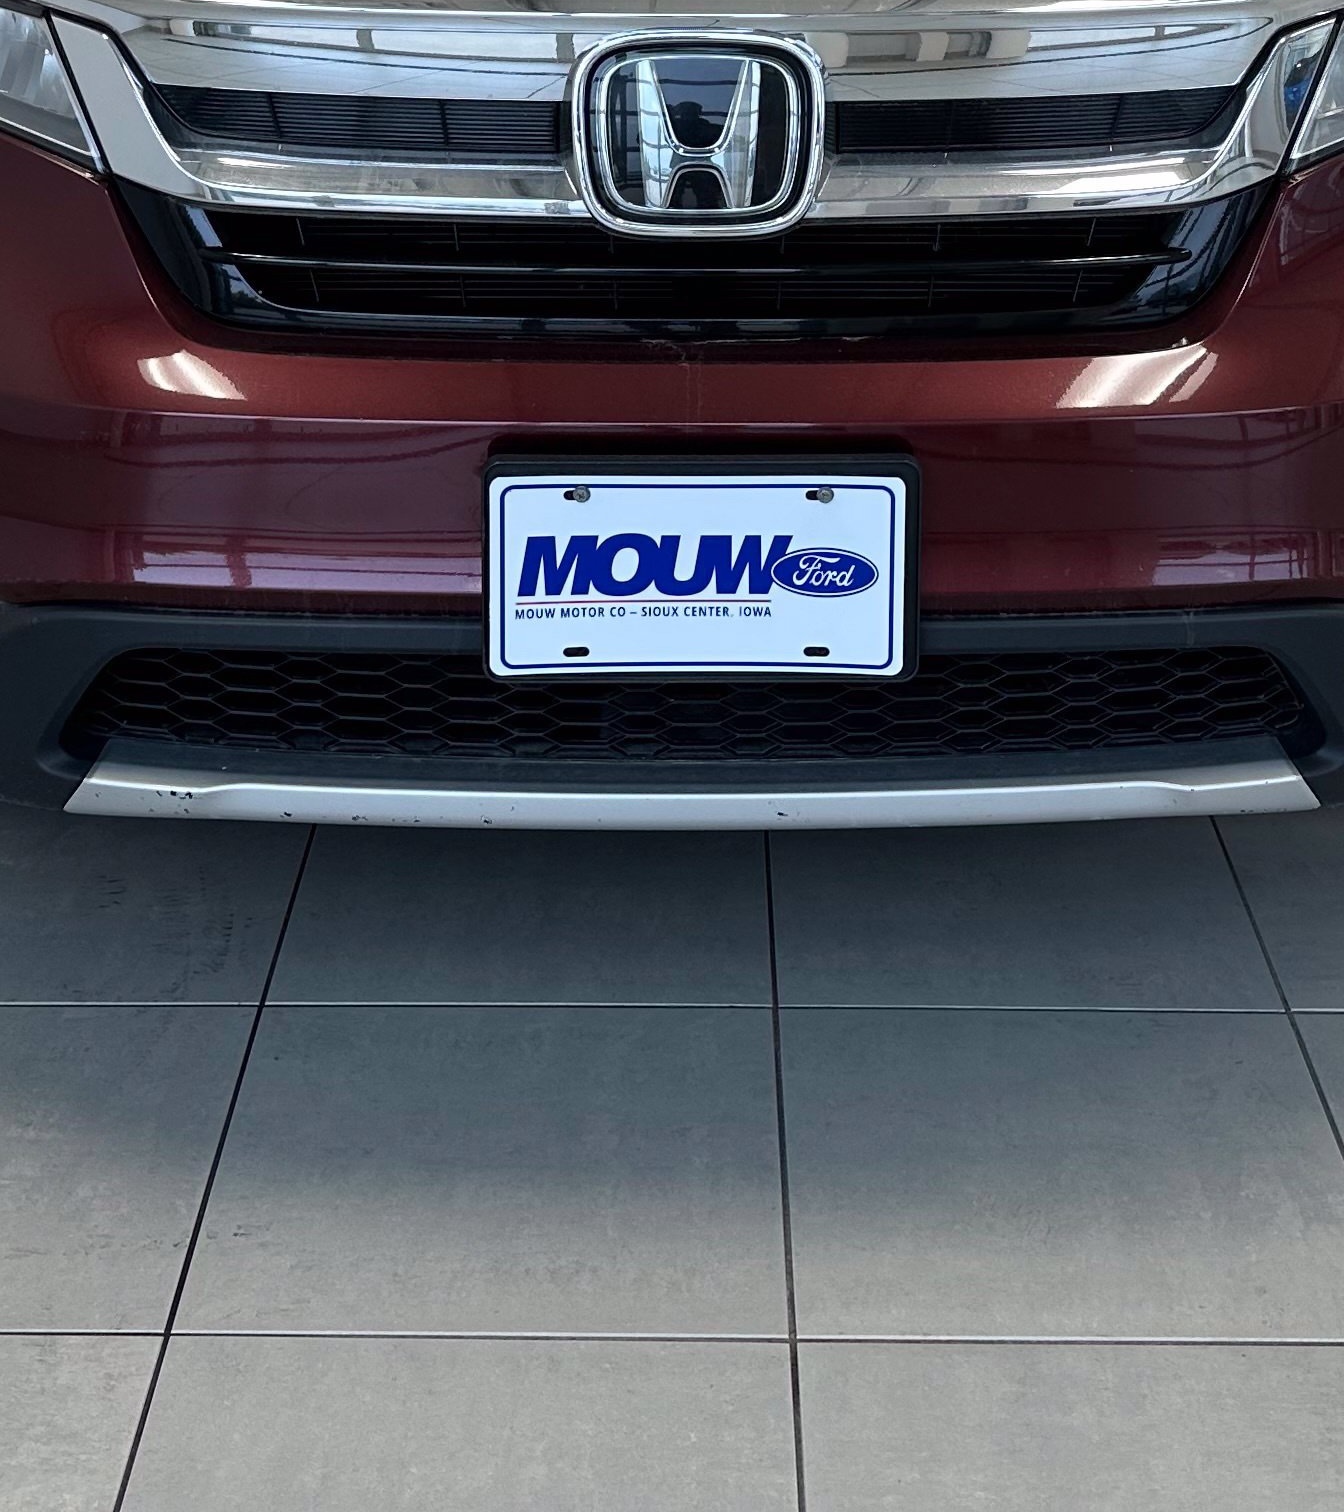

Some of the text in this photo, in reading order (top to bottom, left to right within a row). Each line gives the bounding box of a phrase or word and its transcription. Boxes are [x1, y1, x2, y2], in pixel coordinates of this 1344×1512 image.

[517, 533, 856, 597] MOUW Ford
[515, 608, 556, 619] MOUW
[560, 606, 605, 618] MOTOR
[609, 606, 626, 617] CO
[641, 606, 679, 617] SIOUX
[739, 606, 772, 617] IOWA
